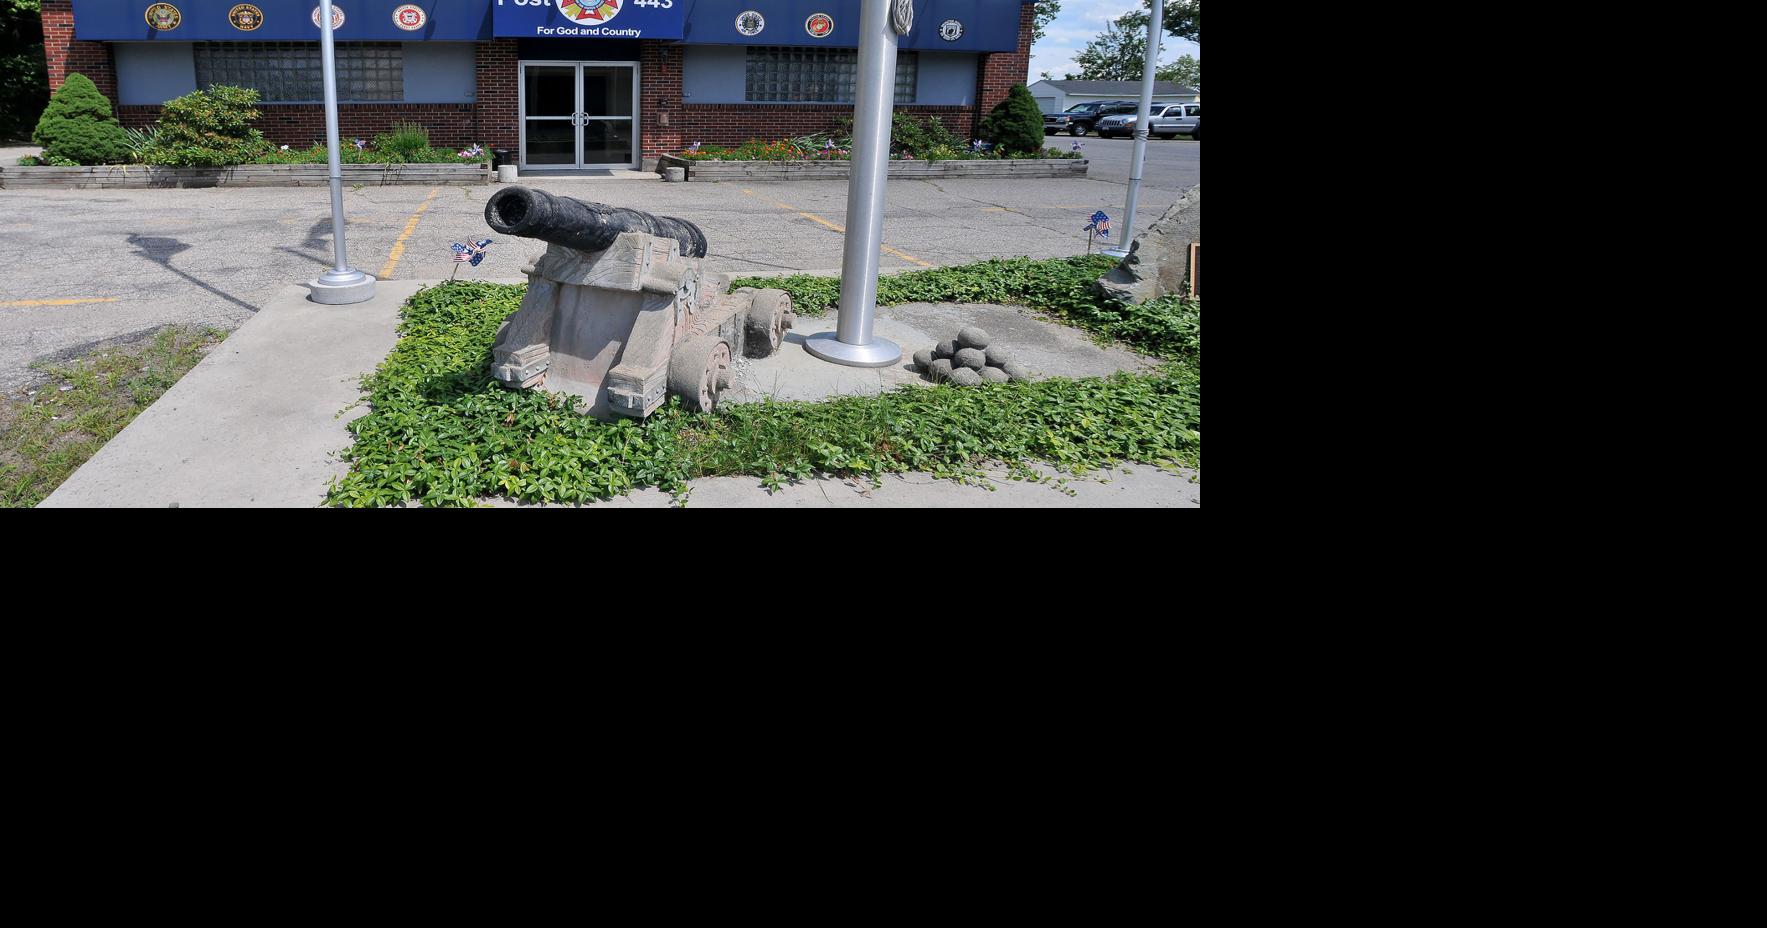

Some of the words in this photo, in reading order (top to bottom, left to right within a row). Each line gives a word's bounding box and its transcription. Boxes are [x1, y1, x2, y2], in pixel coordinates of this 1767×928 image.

[537, 26, 555, 35] For
[556, 26, 578, 35] God
[580, 27, 600, 35] and
[601, 27, 641, 38] Country
